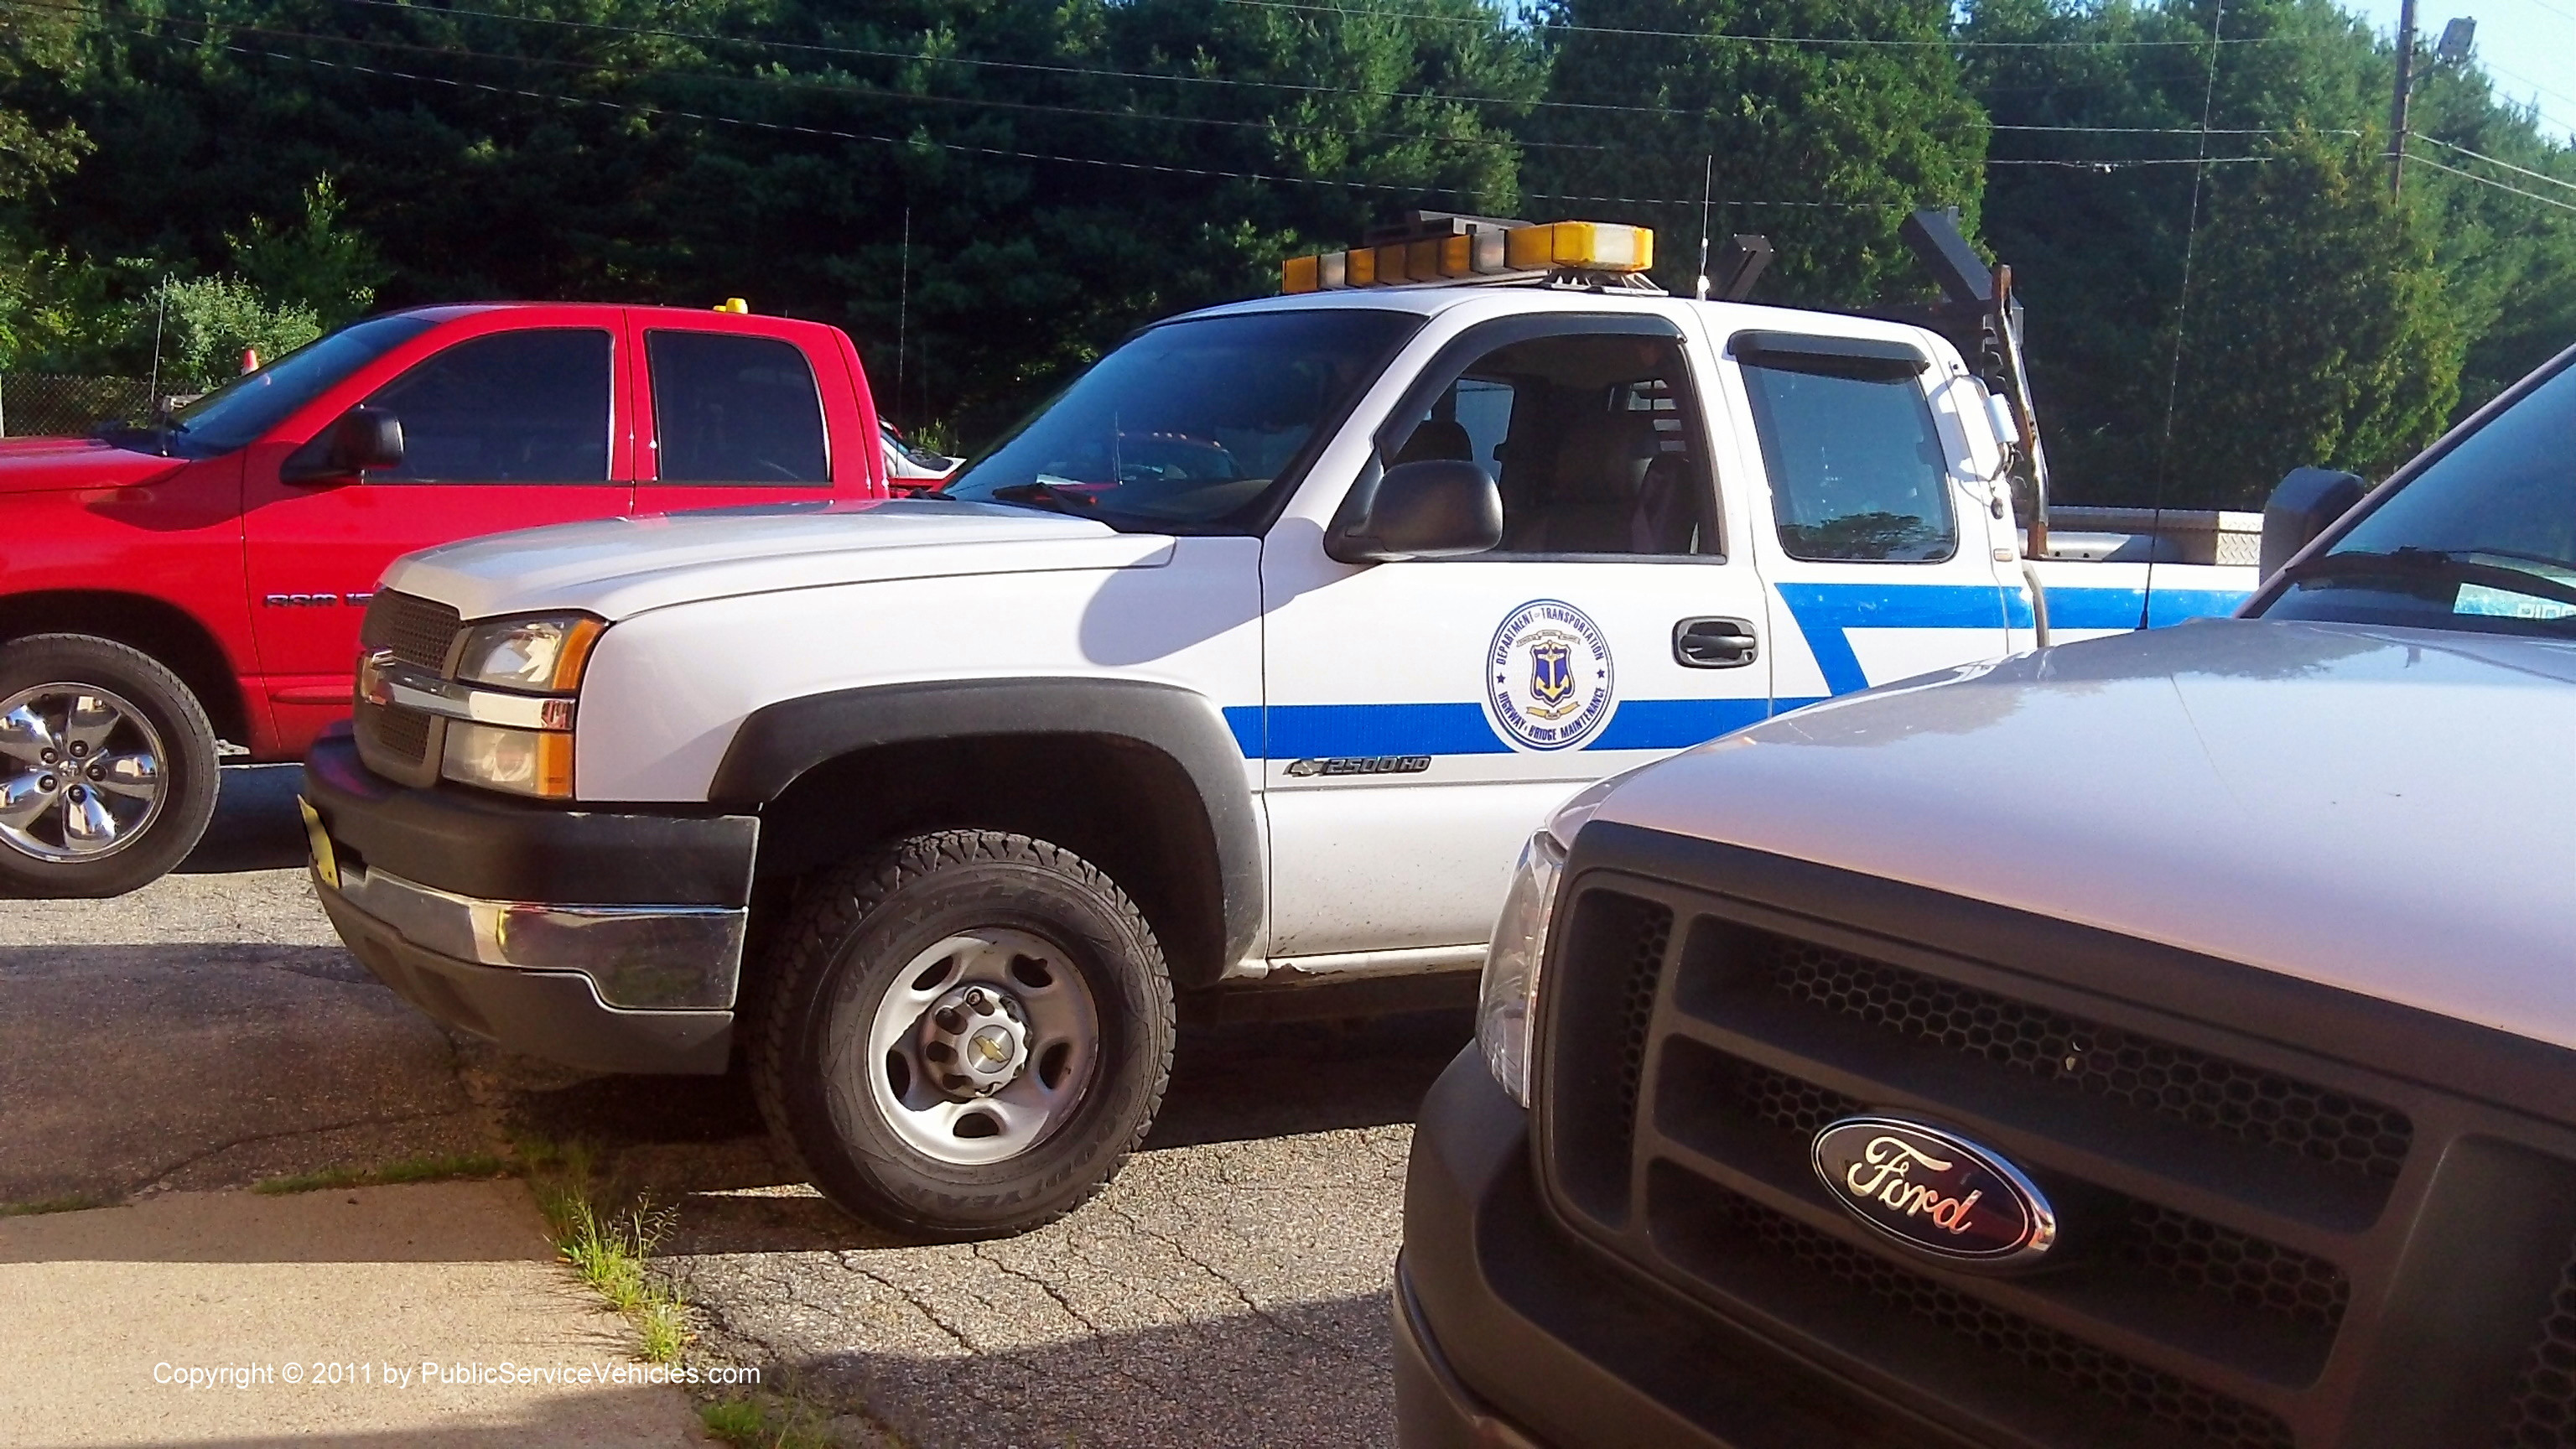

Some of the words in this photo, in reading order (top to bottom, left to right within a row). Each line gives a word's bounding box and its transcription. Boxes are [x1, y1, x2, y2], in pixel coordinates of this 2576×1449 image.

[1496, 610, 1535, 666] DEPARTMENT
[1540, 607, 1605, 661] TRANSPORTATION
[1498, 691, 1526, 730] HIGHWAY
[1528, 724, 1557, 741] BRIDGE
[1560, 687, 1606, 739] MAINTENANCE
[1846, 1136, 1983, 1235] Ford
